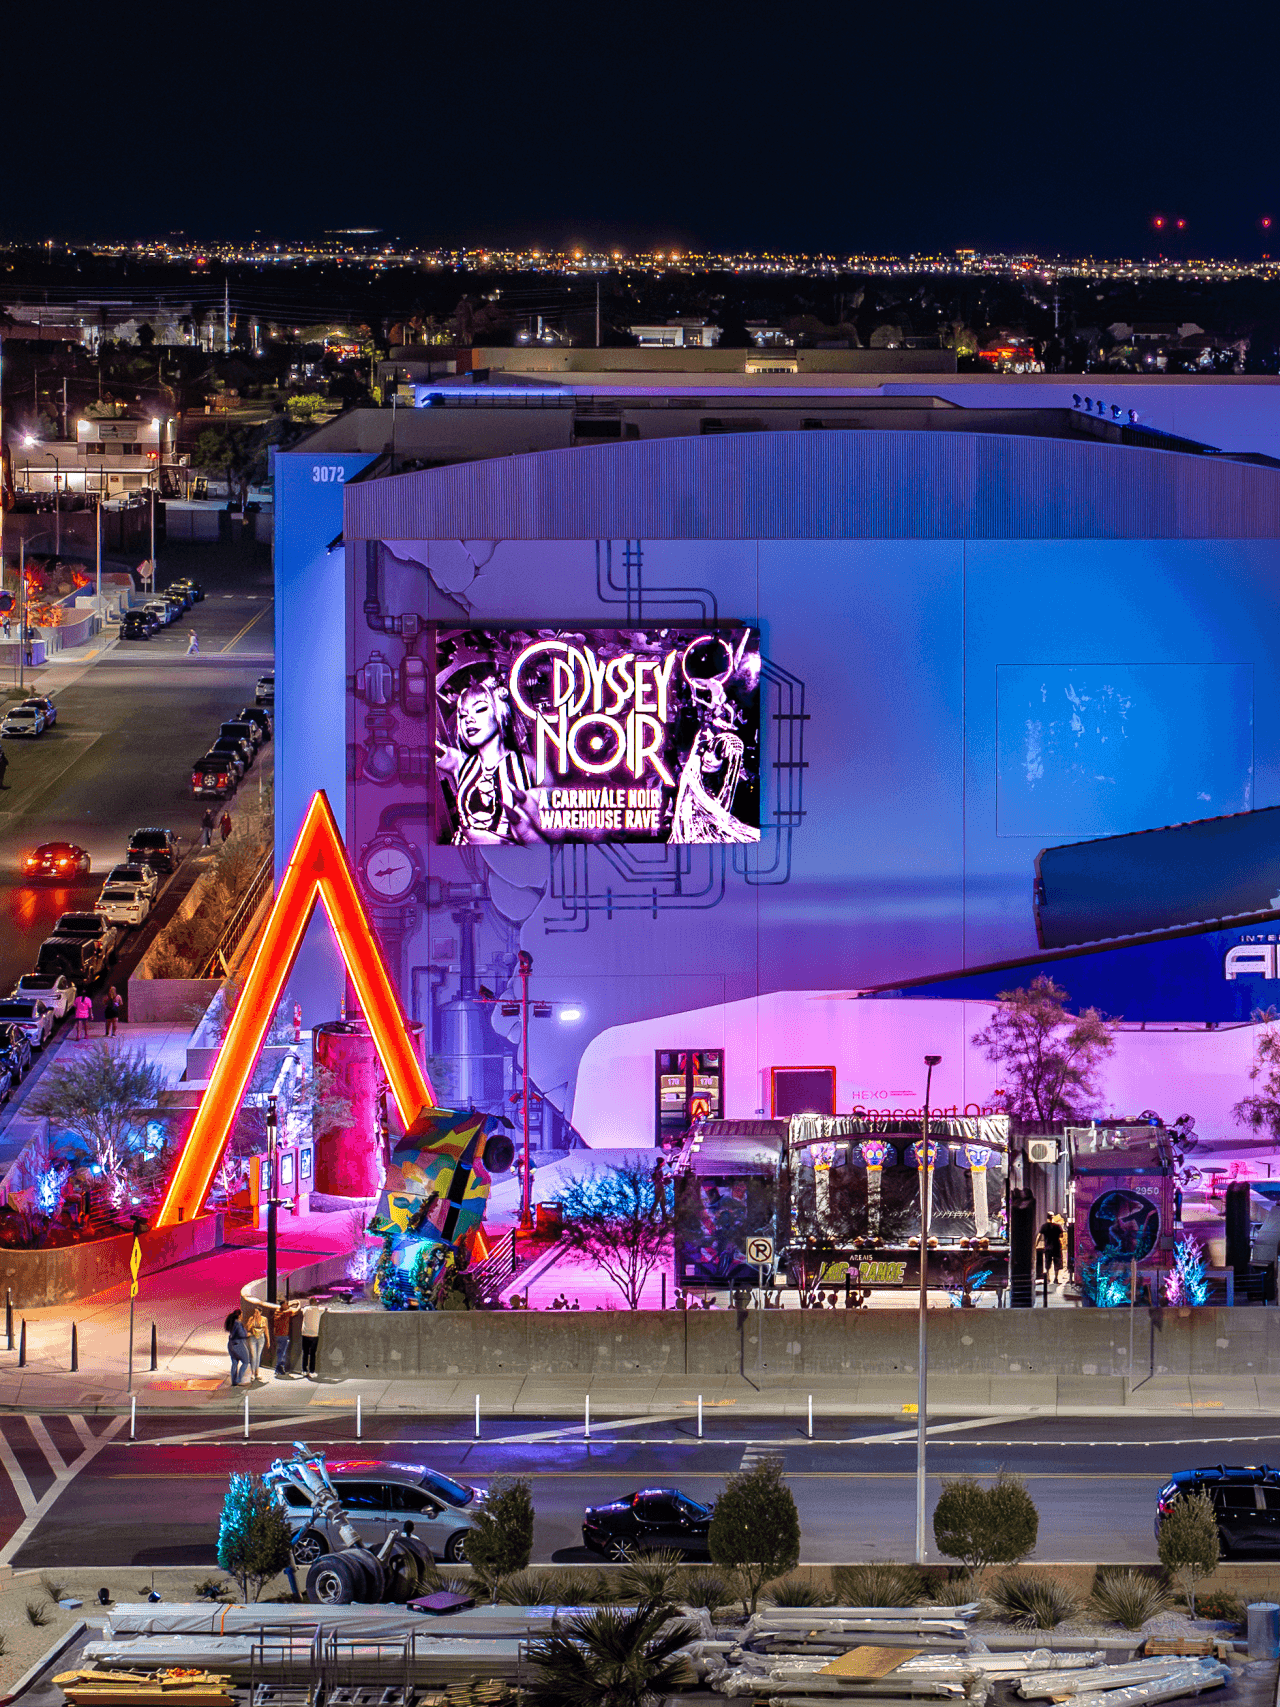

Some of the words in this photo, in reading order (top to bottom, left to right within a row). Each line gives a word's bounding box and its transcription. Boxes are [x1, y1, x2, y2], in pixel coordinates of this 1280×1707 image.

[312, 466, 345, 482] 3072
[510, 640, 677, 723] ODYSSEY
[536, 709, 675, 787] NOIR
[628, 790, 661, 809] NOIR
[540, 810, 621, 830] WAREHOUSE
[625, 810, 660, 829] RAVE
[852, 1090, 888, 1100] HEXO
[1135, 1186, 1160, 1195] 2950
